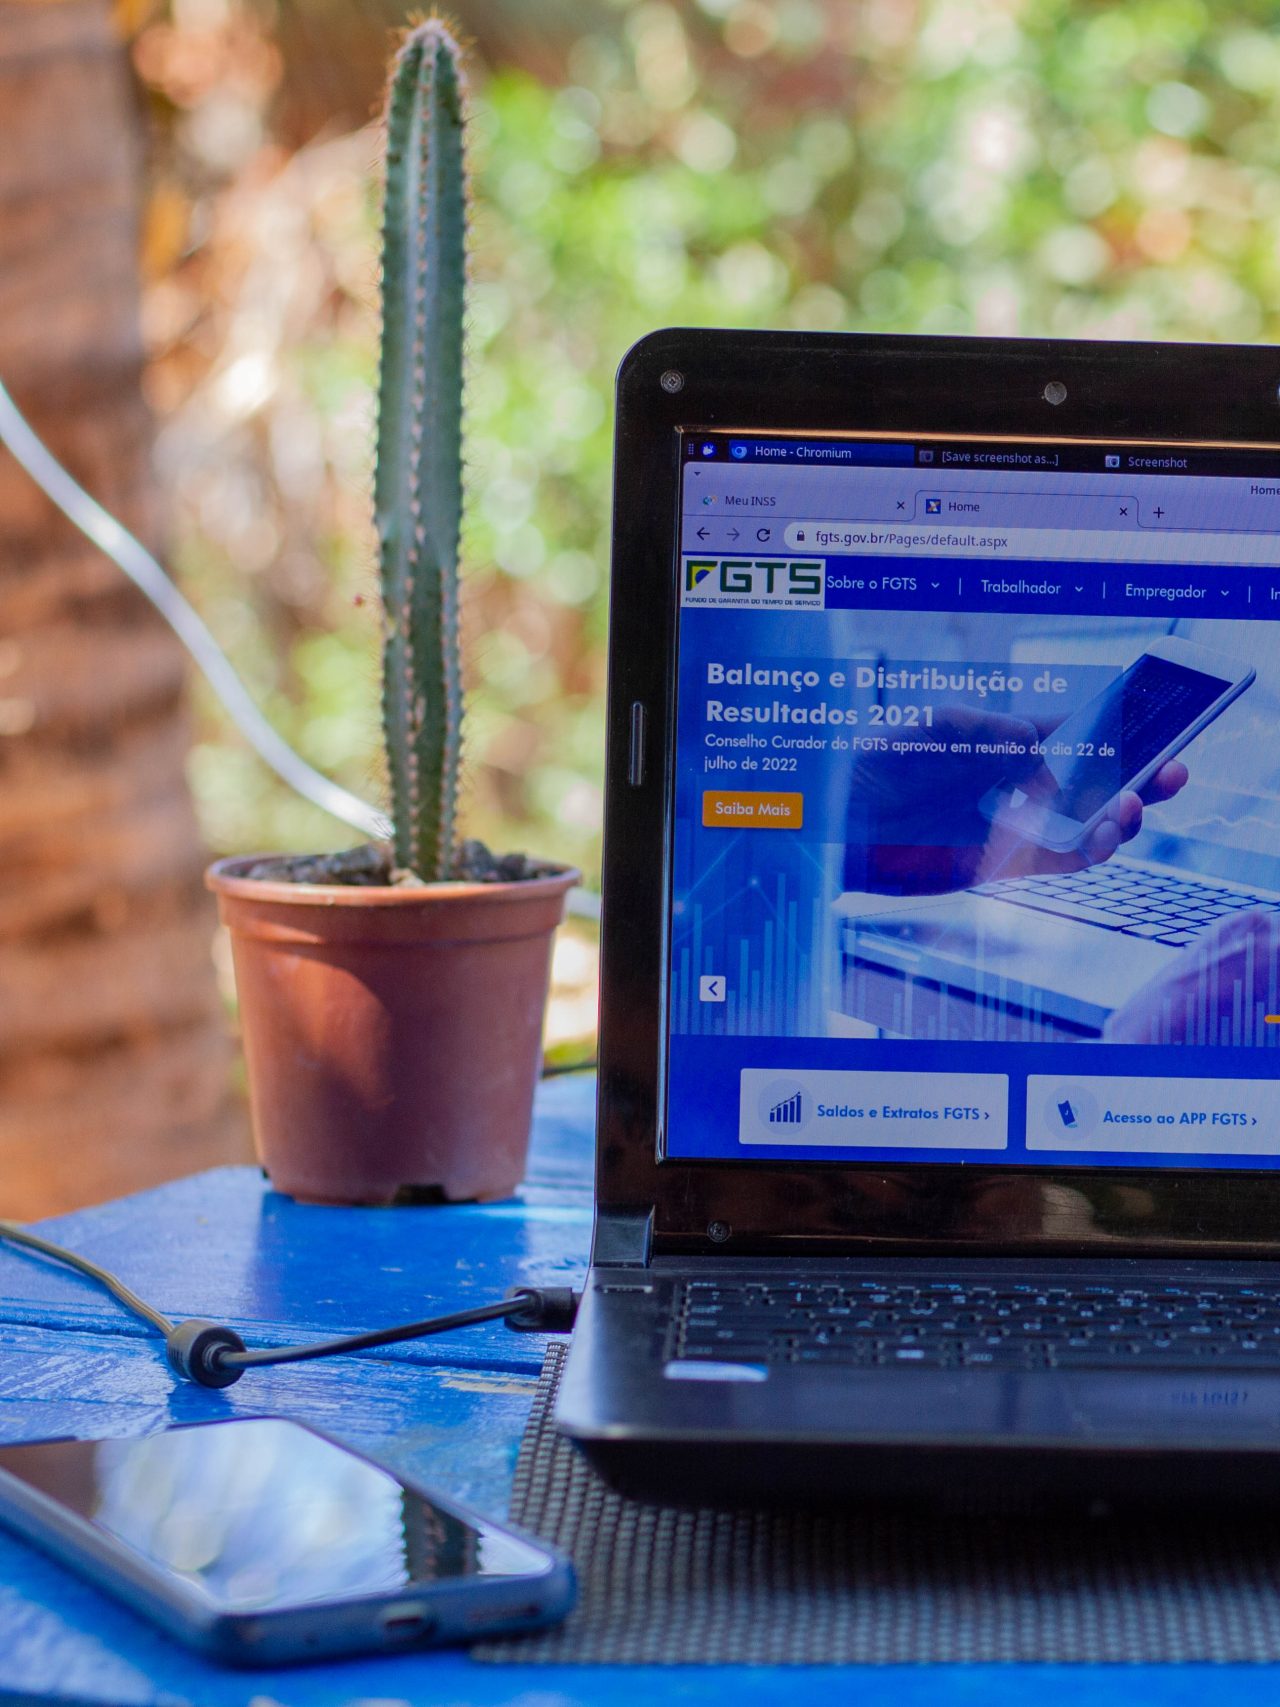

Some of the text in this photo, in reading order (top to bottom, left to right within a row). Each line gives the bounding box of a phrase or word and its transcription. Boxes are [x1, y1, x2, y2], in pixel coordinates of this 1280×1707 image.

[756, 447, 786, 457] Home
[796, 448, 851, 458] Chromium
[976, 452, 1032, 464] screenshot
[1128, 457, 1187, 468] Screenshot
[726, 496, 776, 506] Meu INSS
[949, 502, 980, 512] Home
[816, 531, 1008, 549] fgts.gov.br/Pages/default.aspx
[686, 560, 821, 594] FGTS
[827, 576, 916, 590] Sobre o FGTS
[981, 579, 1061, 594] Trabalhador
[1125, 584, 1206, 601] Empregador
[707, 663, 1068, 697] Balanço e Distribuição de
[706, 700, 933, 726] Resultados 2021
[705, 734, 1115, 757] Conselho Curador do FGTS aprovou em reunião do dia 22 de
[704, 757, 797, 773] julho de 2022
[715, 801, 791, 817] Saiba Mais
[817, 1104, 980, 1121] Saldos e Extratos FGTS
[1104, 1111, 1247, 1127] Acesso ao APP FGTS
